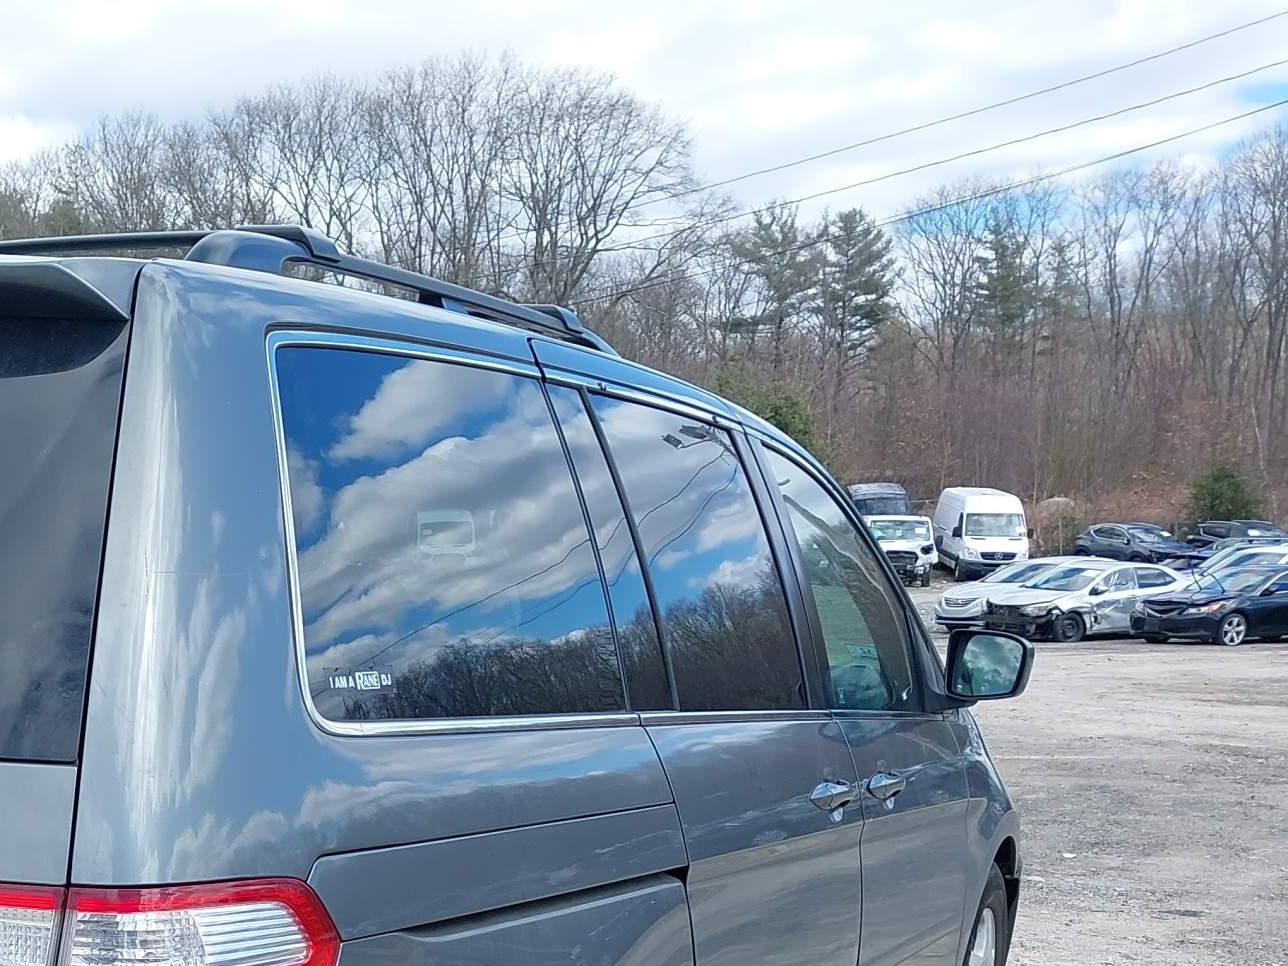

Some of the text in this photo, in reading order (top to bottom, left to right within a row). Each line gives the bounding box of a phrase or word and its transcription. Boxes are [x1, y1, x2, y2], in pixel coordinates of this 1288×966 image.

[329, 671, 392, 691] I AM A RANE DJ
